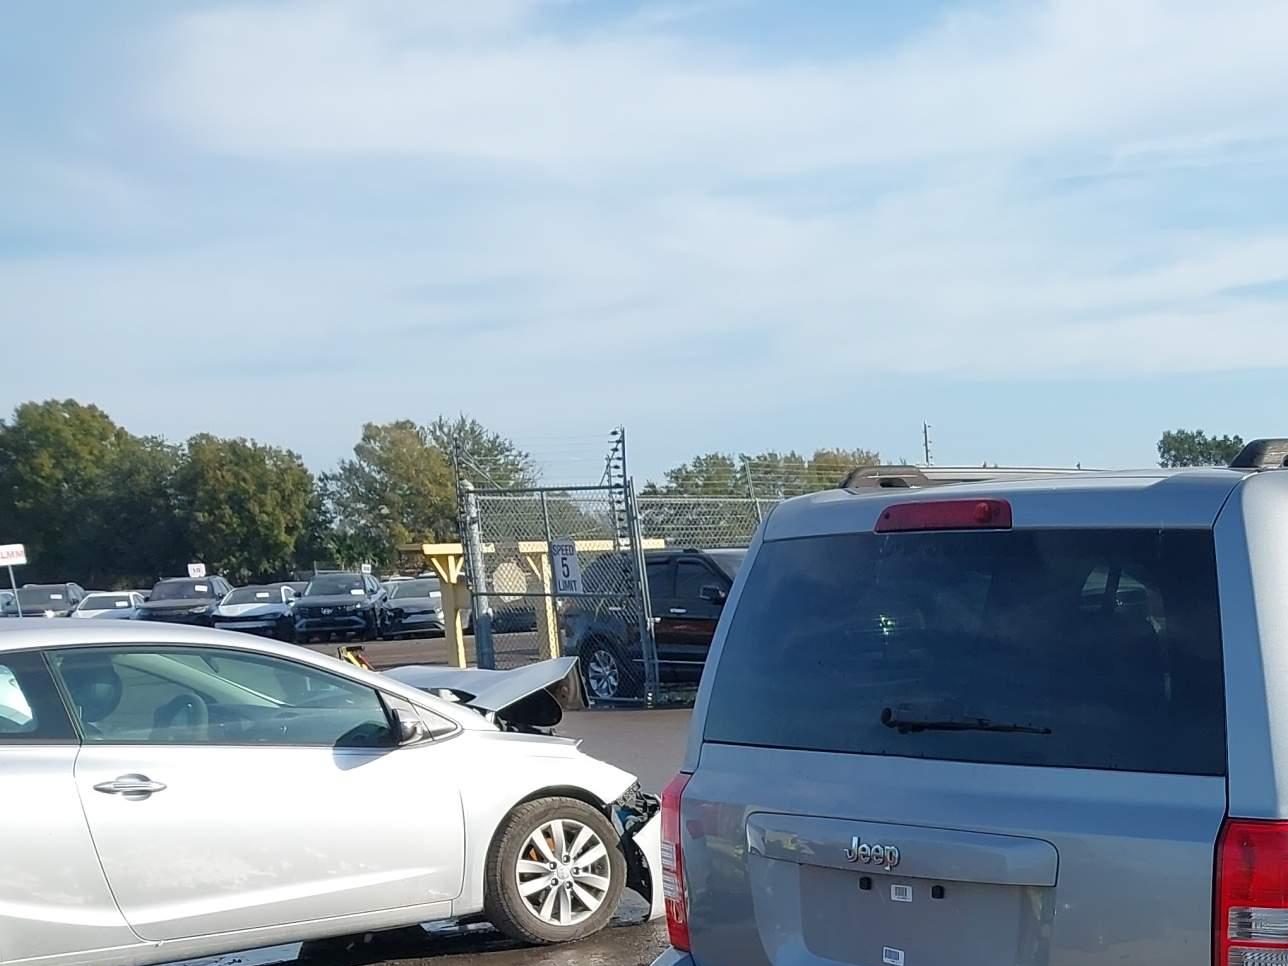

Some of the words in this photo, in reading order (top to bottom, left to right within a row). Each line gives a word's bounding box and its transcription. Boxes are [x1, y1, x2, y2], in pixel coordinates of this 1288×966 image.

[552, 545, 574, 556] SPEED
[561, 557, 570, 578] 5
[558, 580, 577, 592] LIMIT
[843, 836, 901, 871] Jeep
